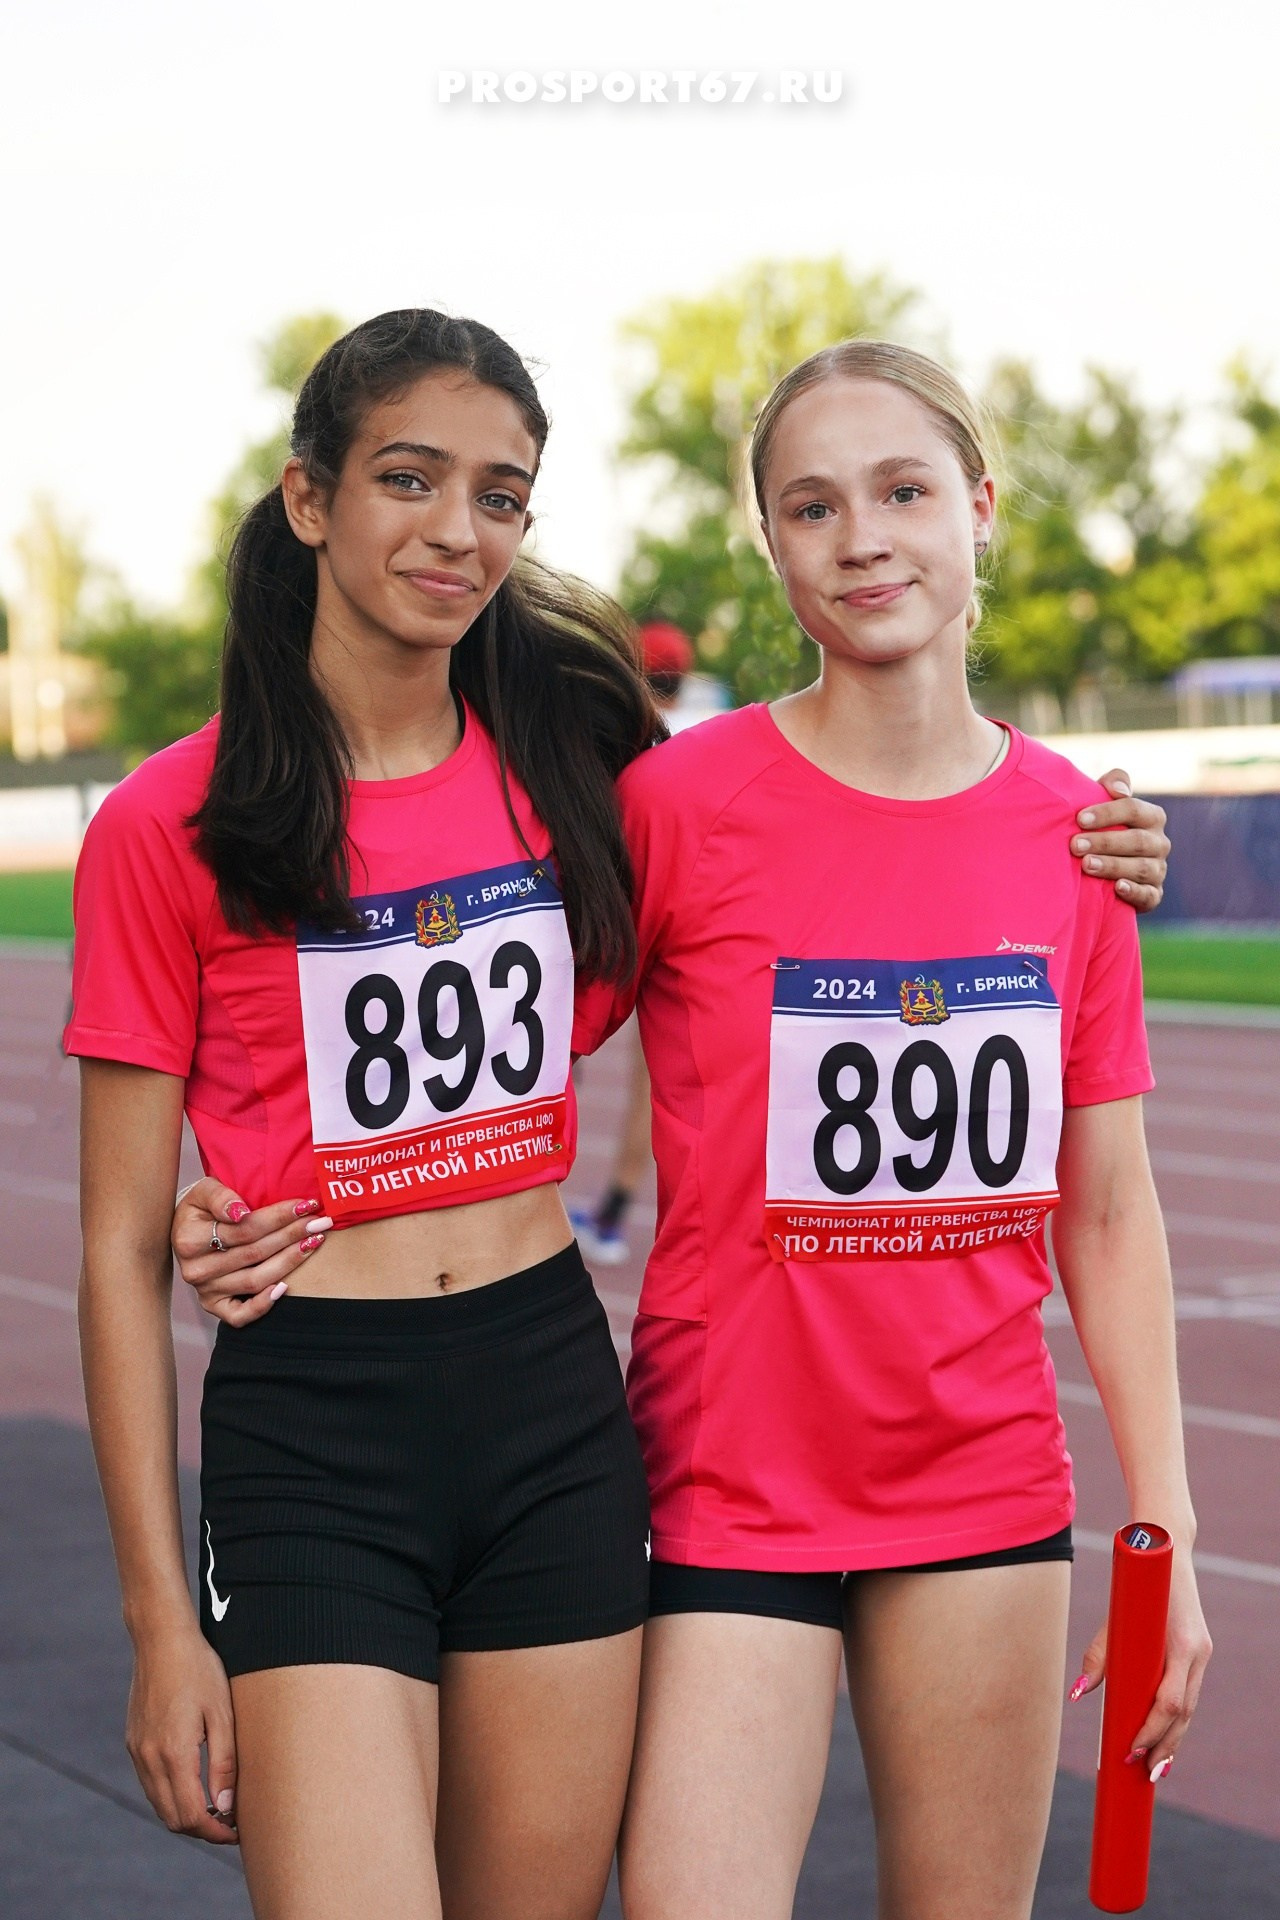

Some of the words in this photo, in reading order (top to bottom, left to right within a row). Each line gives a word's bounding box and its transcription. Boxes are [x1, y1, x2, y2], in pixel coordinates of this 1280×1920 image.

[481, 877, 537, 903] БРЯНСК
[1011, 943, 1057, 955] DEMIX
[812, 978, 877, 1000] 2024
[974, 974, 1038, 992] БРЯНСК
[345, 940, 544, 1129] 893
[813, 1034, 1030, 1195] 890
[324, 1141, 425, 1173] ЧЕМПИОНАТ
[430, 1138, 441, 1152] И
[446, 1117, 533, 1149] ПЕРВЕНСТВА
[535, 1112, 554, 1129] ЦФО
[327, 1179, 364, 1200] ПО
[371, 1151, 468, 1194] ЛЕГКОЙ
[474, 1134, 554, 1171] АТЛЕТИКЕ
[785, 1235, 819, 1252] ПО
[825, 1230, 923, 1253] ЛЕГКОЙ
[930, 1214, 1039, 1251] АТЛЕТИКЕ
[787, 1216, 890, 1229] ЧЕМПИОНАТ
[894, 1216, 906, 1228] И
[910, 1210, 1008, 1227] ПЕРВЕНСТВА
